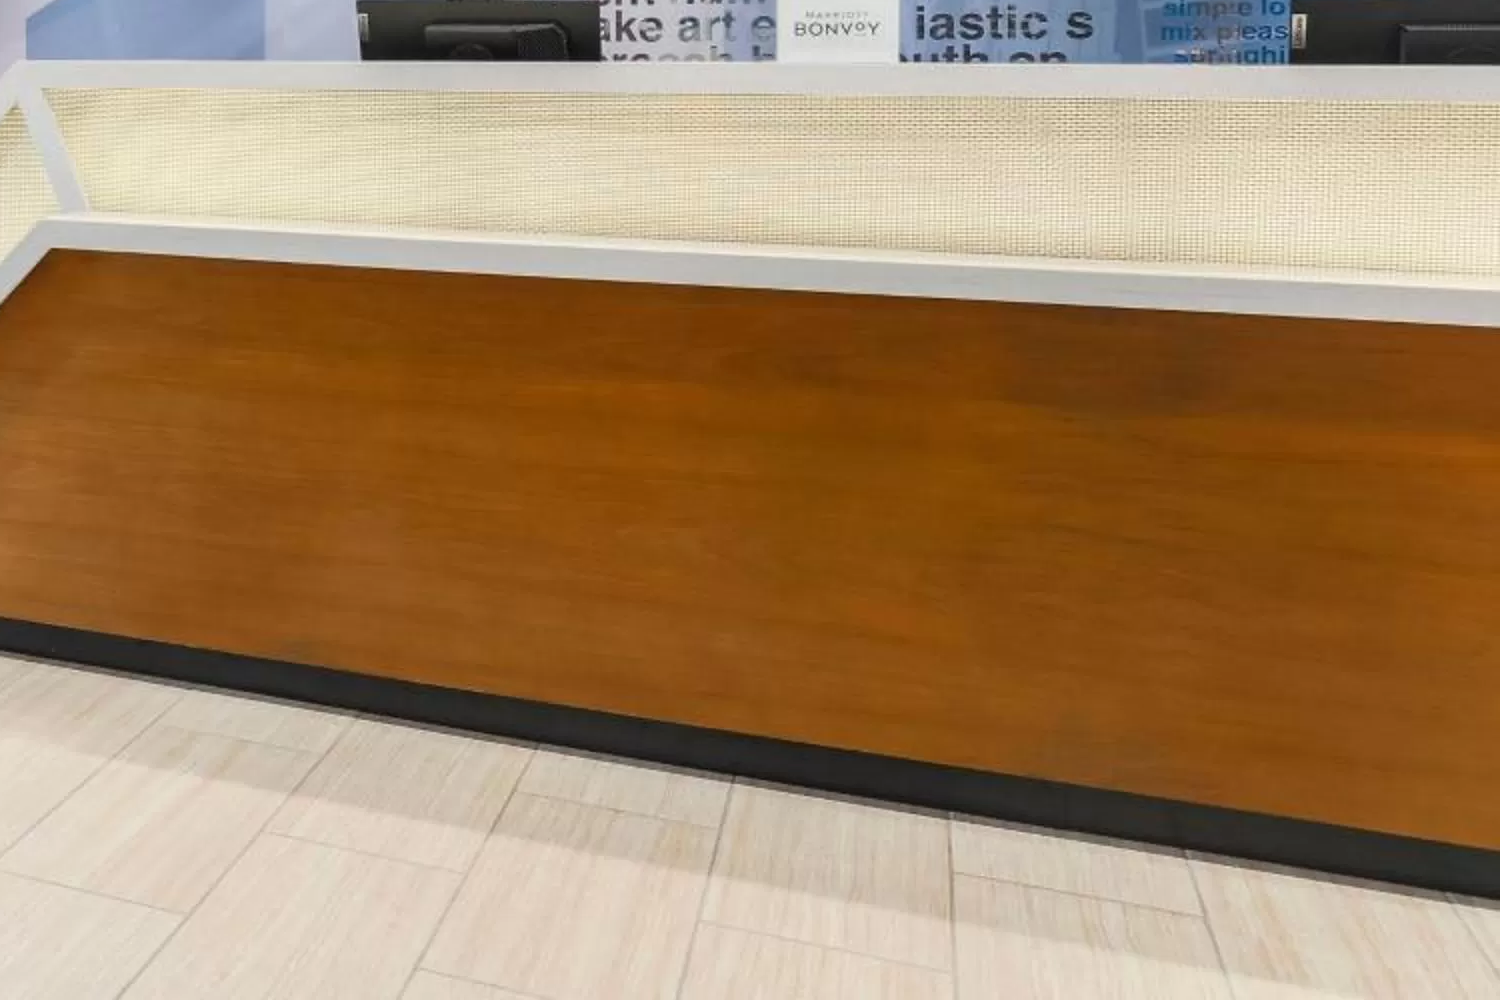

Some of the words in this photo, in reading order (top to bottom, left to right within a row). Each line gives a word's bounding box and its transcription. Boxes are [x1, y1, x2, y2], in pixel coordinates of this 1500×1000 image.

[677, 10, 737, 43] art
[794, 21, 882, 37] BONVOY
[915, 5, 1049, 41] iastic
[1065, 10, 1094, 40] s
